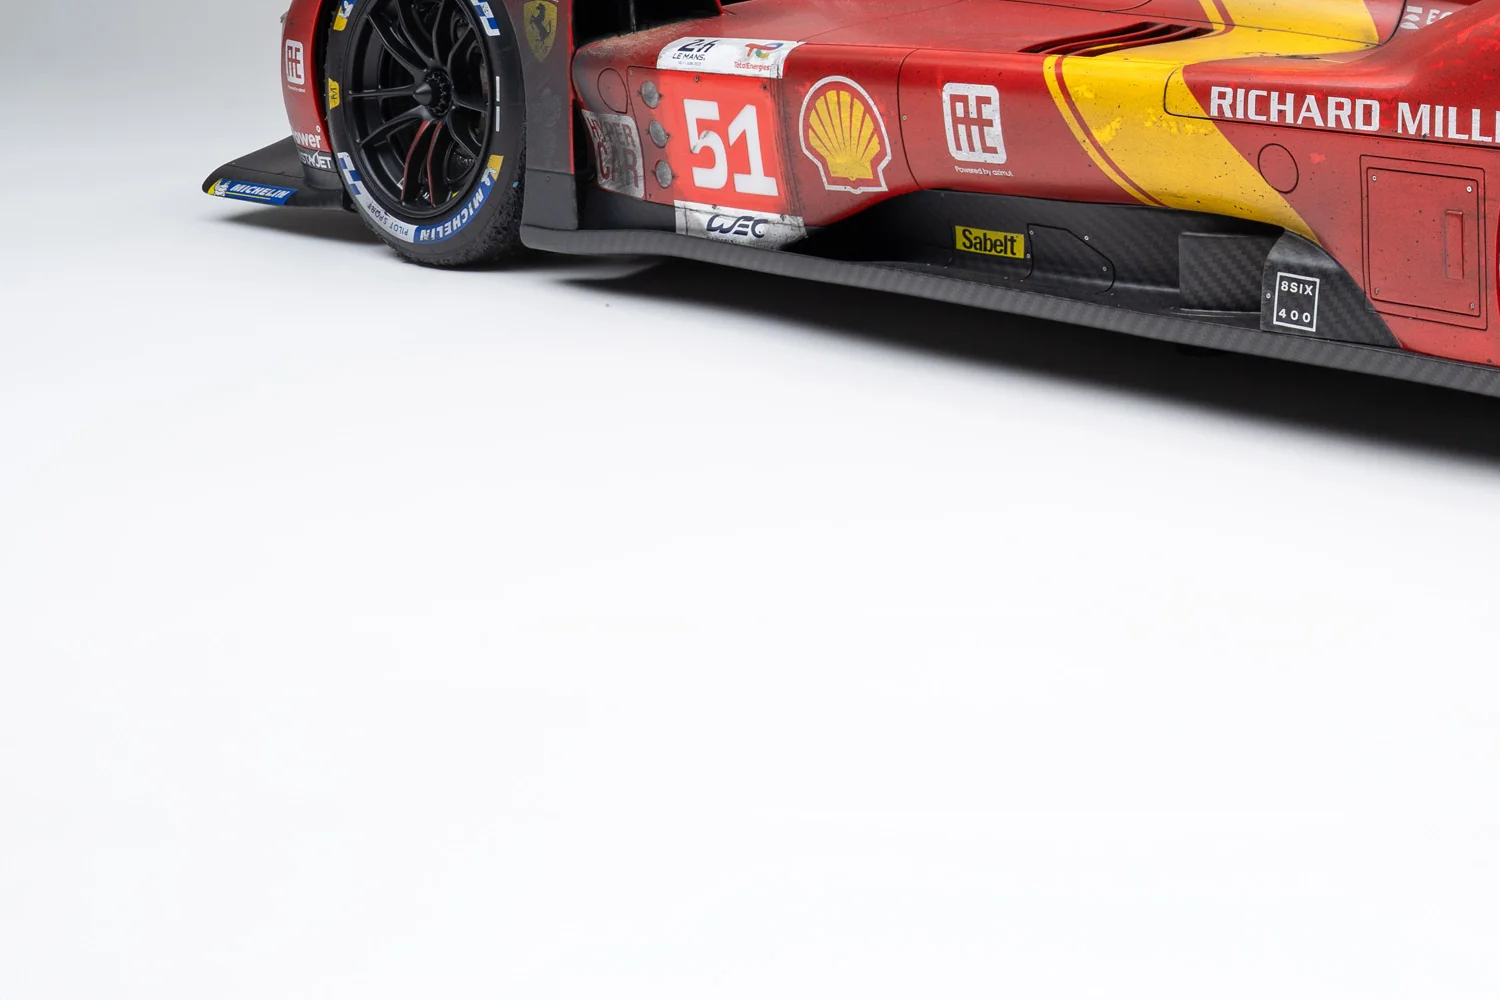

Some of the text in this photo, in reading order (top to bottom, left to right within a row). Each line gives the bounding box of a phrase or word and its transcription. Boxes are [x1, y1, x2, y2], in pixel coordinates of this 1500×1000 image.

[734, 61, 771, 72] TotalEnergies
[1210, 86, 1380, 132] RICHARD
[683, 98, 779, 197] 51
[229, 182, 291, 200] MICHELIN
[366, 199, 390, 226] SPORT
[419, 189, 485, 242] MICHELIN
[706, 214, 769, 238] WEC
[961, 228, 1018, 256] Sabelt
[1280, 280, 1313, 296] 8SIX
[1278, 308, 1311, 323] 400
